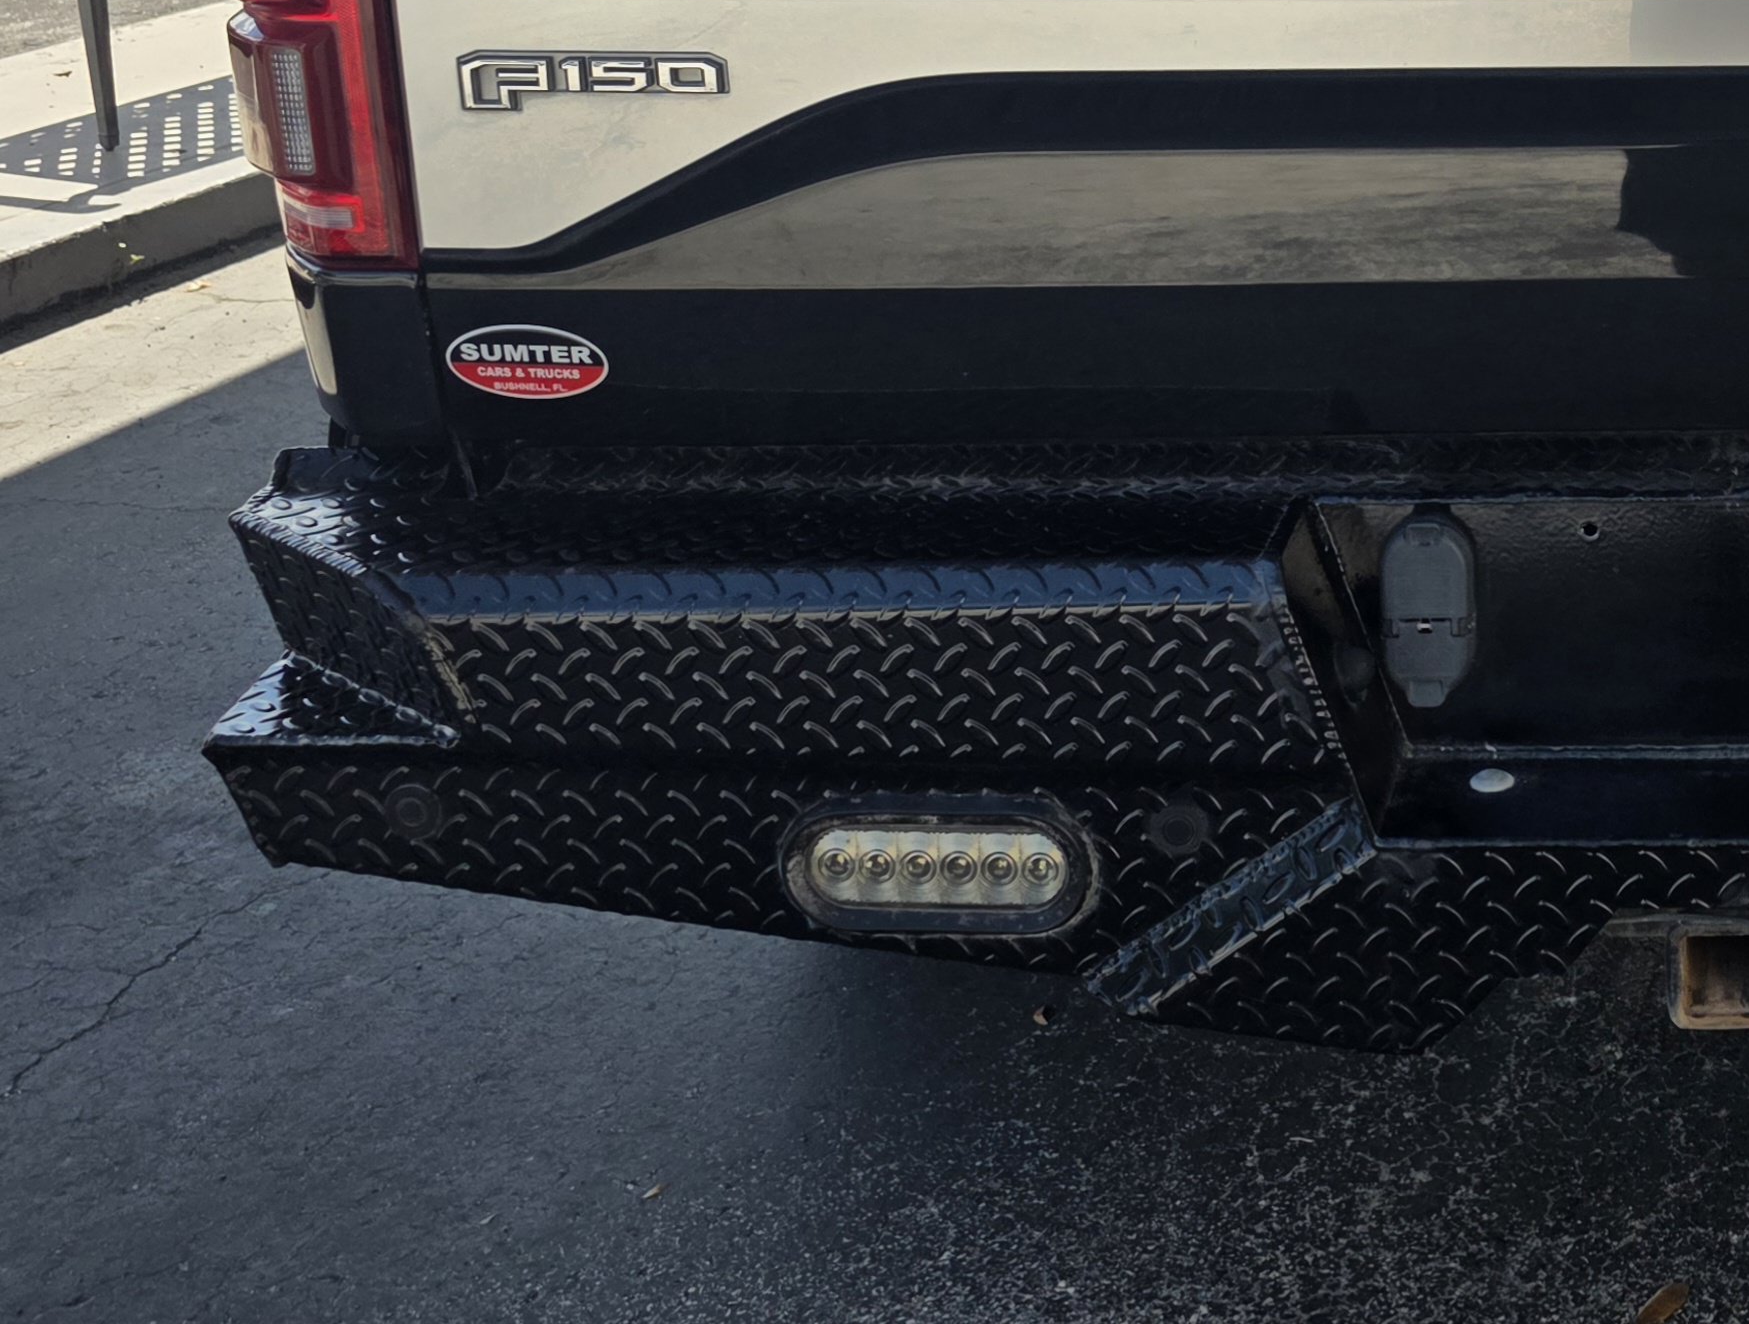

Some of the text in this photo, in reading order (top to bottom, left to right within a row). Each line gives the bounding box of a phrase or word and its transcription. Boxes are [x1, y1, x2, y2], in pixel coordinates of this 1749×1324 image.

[459, 343, 593, 364] SUMTER
[477, 366, 581, 379] CARS & TRUCKS
